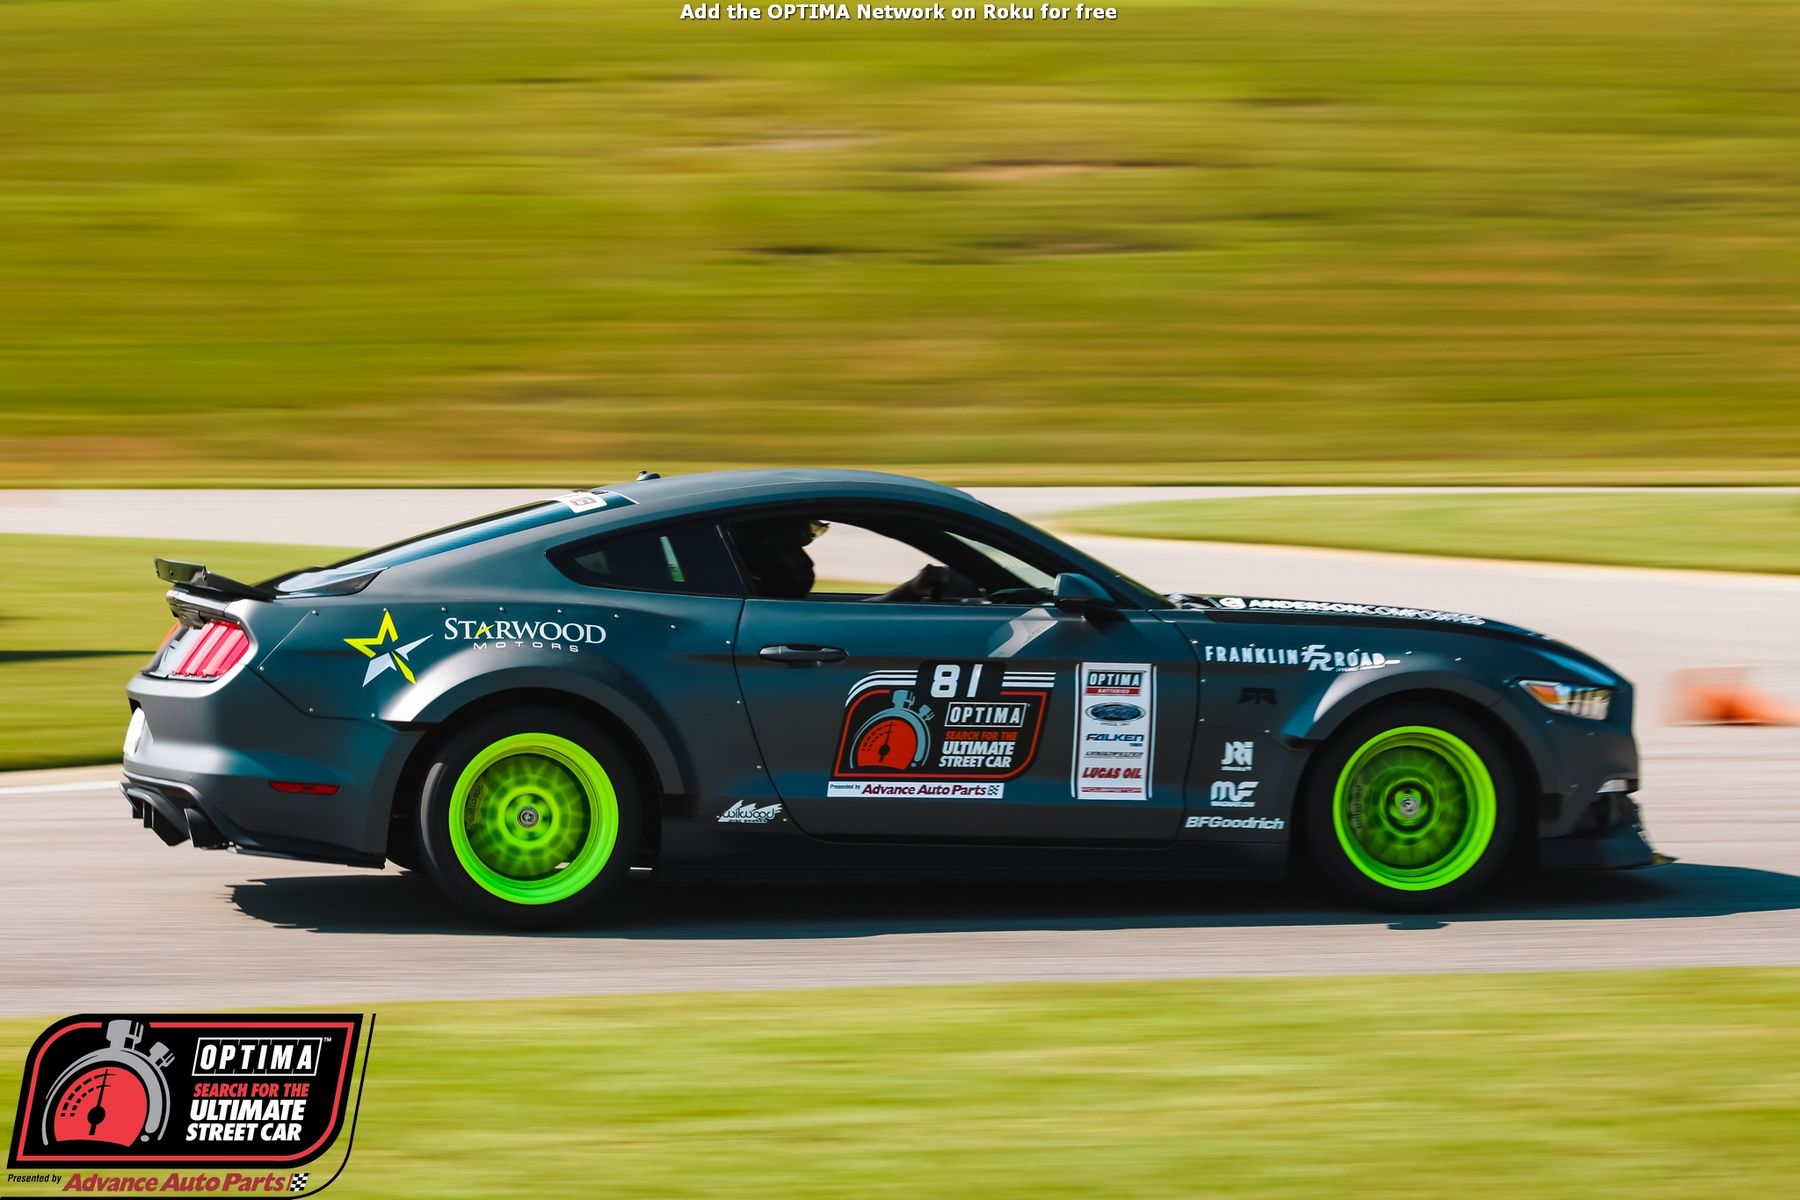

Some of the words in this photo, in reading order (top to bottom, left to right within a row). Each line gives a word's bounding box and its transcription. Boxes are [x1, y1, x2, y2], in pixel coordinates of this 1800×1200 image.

[444, 617, 607, 644] STARWOOD
[473, 641, 579, 653] MOTORS
[1205, 645, 1299, 665] FRANKLIN
[1334, 651, 1386, 667] ROAD
[930, 664, 983, 698] 81
[1089, 673, 1140, 686] OPTIMA
[949, 706, 1021, 724] OPTIMA
[945, 731, 980, 741] SEARCH
[981, 731, 999, 741] FOR
[1001, 731, 1018, 741] THE
[1086, 733, 1145, 742] FALKEN
[942, 741, 1016, 755] ULTIMATE
[939, 755, 985, 768] STREET
[985, 756, 1012, 768] CAR
[1082, 767, 1121, 779] LUCAS
[1123, 767, 1142, 779] OIL
[862, 783, 916, 795] Advance
[916, 784, 951, 795] Auto
[951, 785, 987, 796] Parts
[1185, 816, 1285, 830] BFGoodrich
